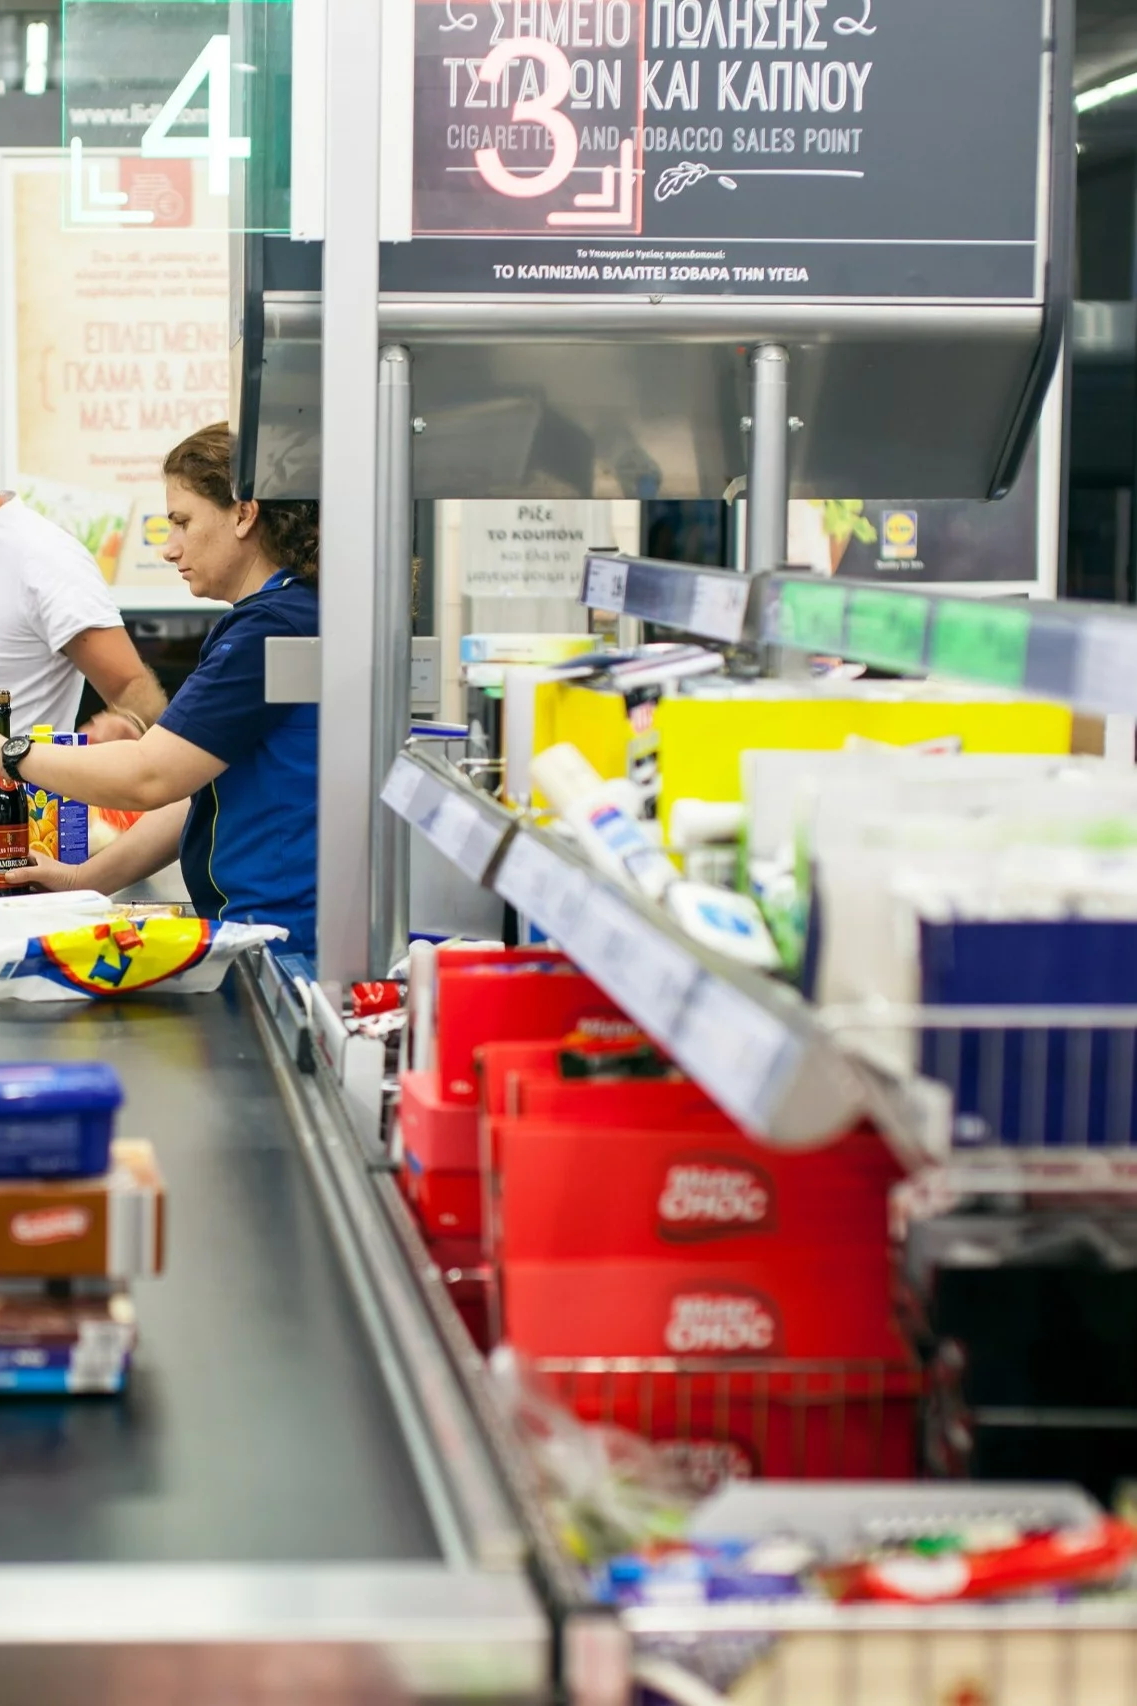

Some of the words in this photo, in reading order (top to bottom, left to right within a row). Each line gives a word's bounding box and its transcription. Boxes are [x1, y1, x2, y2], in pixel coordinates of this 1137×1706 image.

[488, 0, 632, 48] ΣΗΜΕΙΟ
[651, 0, 828, 50] ΠΩΛΗΣΗΣ
[443, 57, 622, 110] ΤΣΙΓΑΩΝ
[642, 59, 700, 111] ΚΑΙ
[717, 60, 873, 113] ΚΑΠΝΟΥ
[141, 34, 252, 196] 4
[474, 36, 579, 198] 3
[447, 124, 559, 150] CIGARETTE
[579, 126, 620, 151] AND
[630, 126, 724, 153] TOBACCO
[732, 127, 796, 154] SALES
[804, 128, 863, 154] POINT
[577, 249, 588, 258] Το
[589, 249, 635, 261] Υπουργείο
[636, 249, 664, 261] Υγείας
[493, 265, 514, 279] ΤΟ
[518, 265, 599, 280] ΚΑΠΝΙΣΜΑ
[602, 266, 666, 280] ΒΛΑΠΤΕΙ
[670, 266, 730, 281] ΣΟΒΑΡΑ
[732, 267, 764, 281] ΤΗΝ
[767, 267, 809, 282] ΥΓΕΙΑ
[155, 360, 172, 391] &
[80, 400, 131, 430] ΜΑΣ
